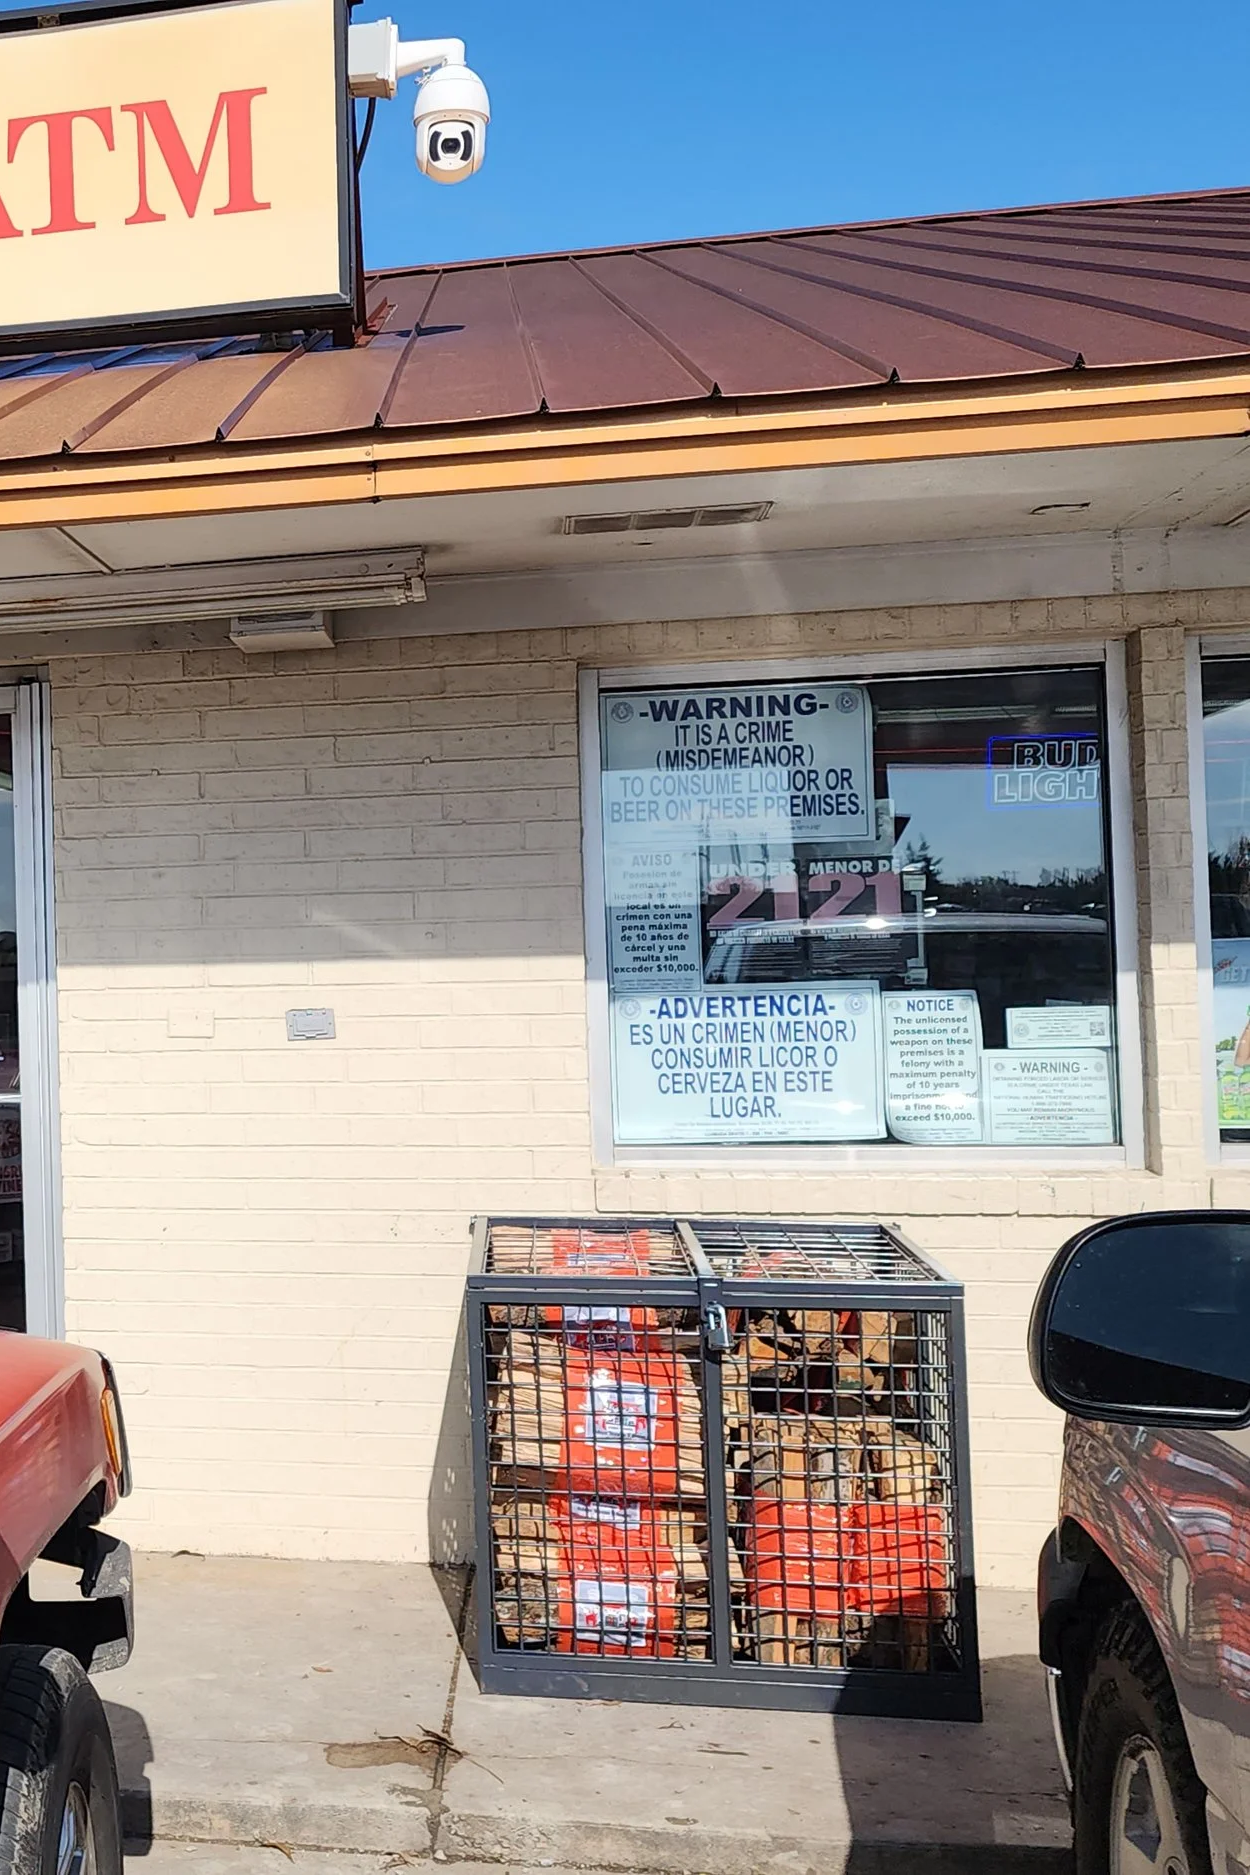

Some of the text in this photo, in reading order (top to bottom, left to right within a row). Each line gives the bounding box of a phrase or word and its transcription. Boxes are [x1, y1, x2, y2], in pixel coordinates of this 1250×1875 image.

[675, 720, 794, 747] IT IS A CRIME
[656, 744, 814, 772] (MISDEMEANOR)
[620, 768, 854, 798] TO CONSUME LIQUOR OR
[610, 793, 865, 823] BEER ON THESE PREMISES.
[631, 854, 673, 867] AVISO
[711, 861, 797, 877] UNDER
[808, 859, 873, 876] MENOR
[706, 875, 800, 930] 21
[806, 871, 901, 929] 21
[616, 911, 693, 921] crimen con una
[621, 921, 688, 933] pena máxima
[620, 931, 689, 942] de 10 años de
[658, 944, 665, 953] y
[668, 943, 686, 951] una
[633, 953, 679, 962] multa sin
[614, 963, 699, 973] exceder $10,000.
[906, 999, 954, 1012] NOTICE
[915, 1015, 968, 1024] unlicensed
[630, 1018, 857, 1045] ES UN CRIMEN (MENOR)
[893, 1027, 948, 1036] possession
[951, 1026, 960, 1034] of
[890, 1039, 929, 1047] weapon
[946, 1037, 973, 1045] these
[651, 1045, 838, 1070] CONSUMIR LICOR O
[900, 1049, 944, 1058] premises
[947, 1048, 956, 1056] is
[901, 1059, 930, 1069] felony
[933, 1059, 955, 1067] with
[1020, 1061, 1081, 1074] WARNING
[889, 1070, 976, 1080] maximum penalty
[658, 1071, 833, 1094] CERVEZA EN ESTE
[906, 1081, 916, 1089] of
[933, 1081, 960, 1090] years
[890, 1091, 945, 1100] imprisonm
[710, 1096, 782, 1119] LUGAR.
[914, 1102, 932, 1110] fine
[895, 1112, 976, 1122] exceed $10,000.
